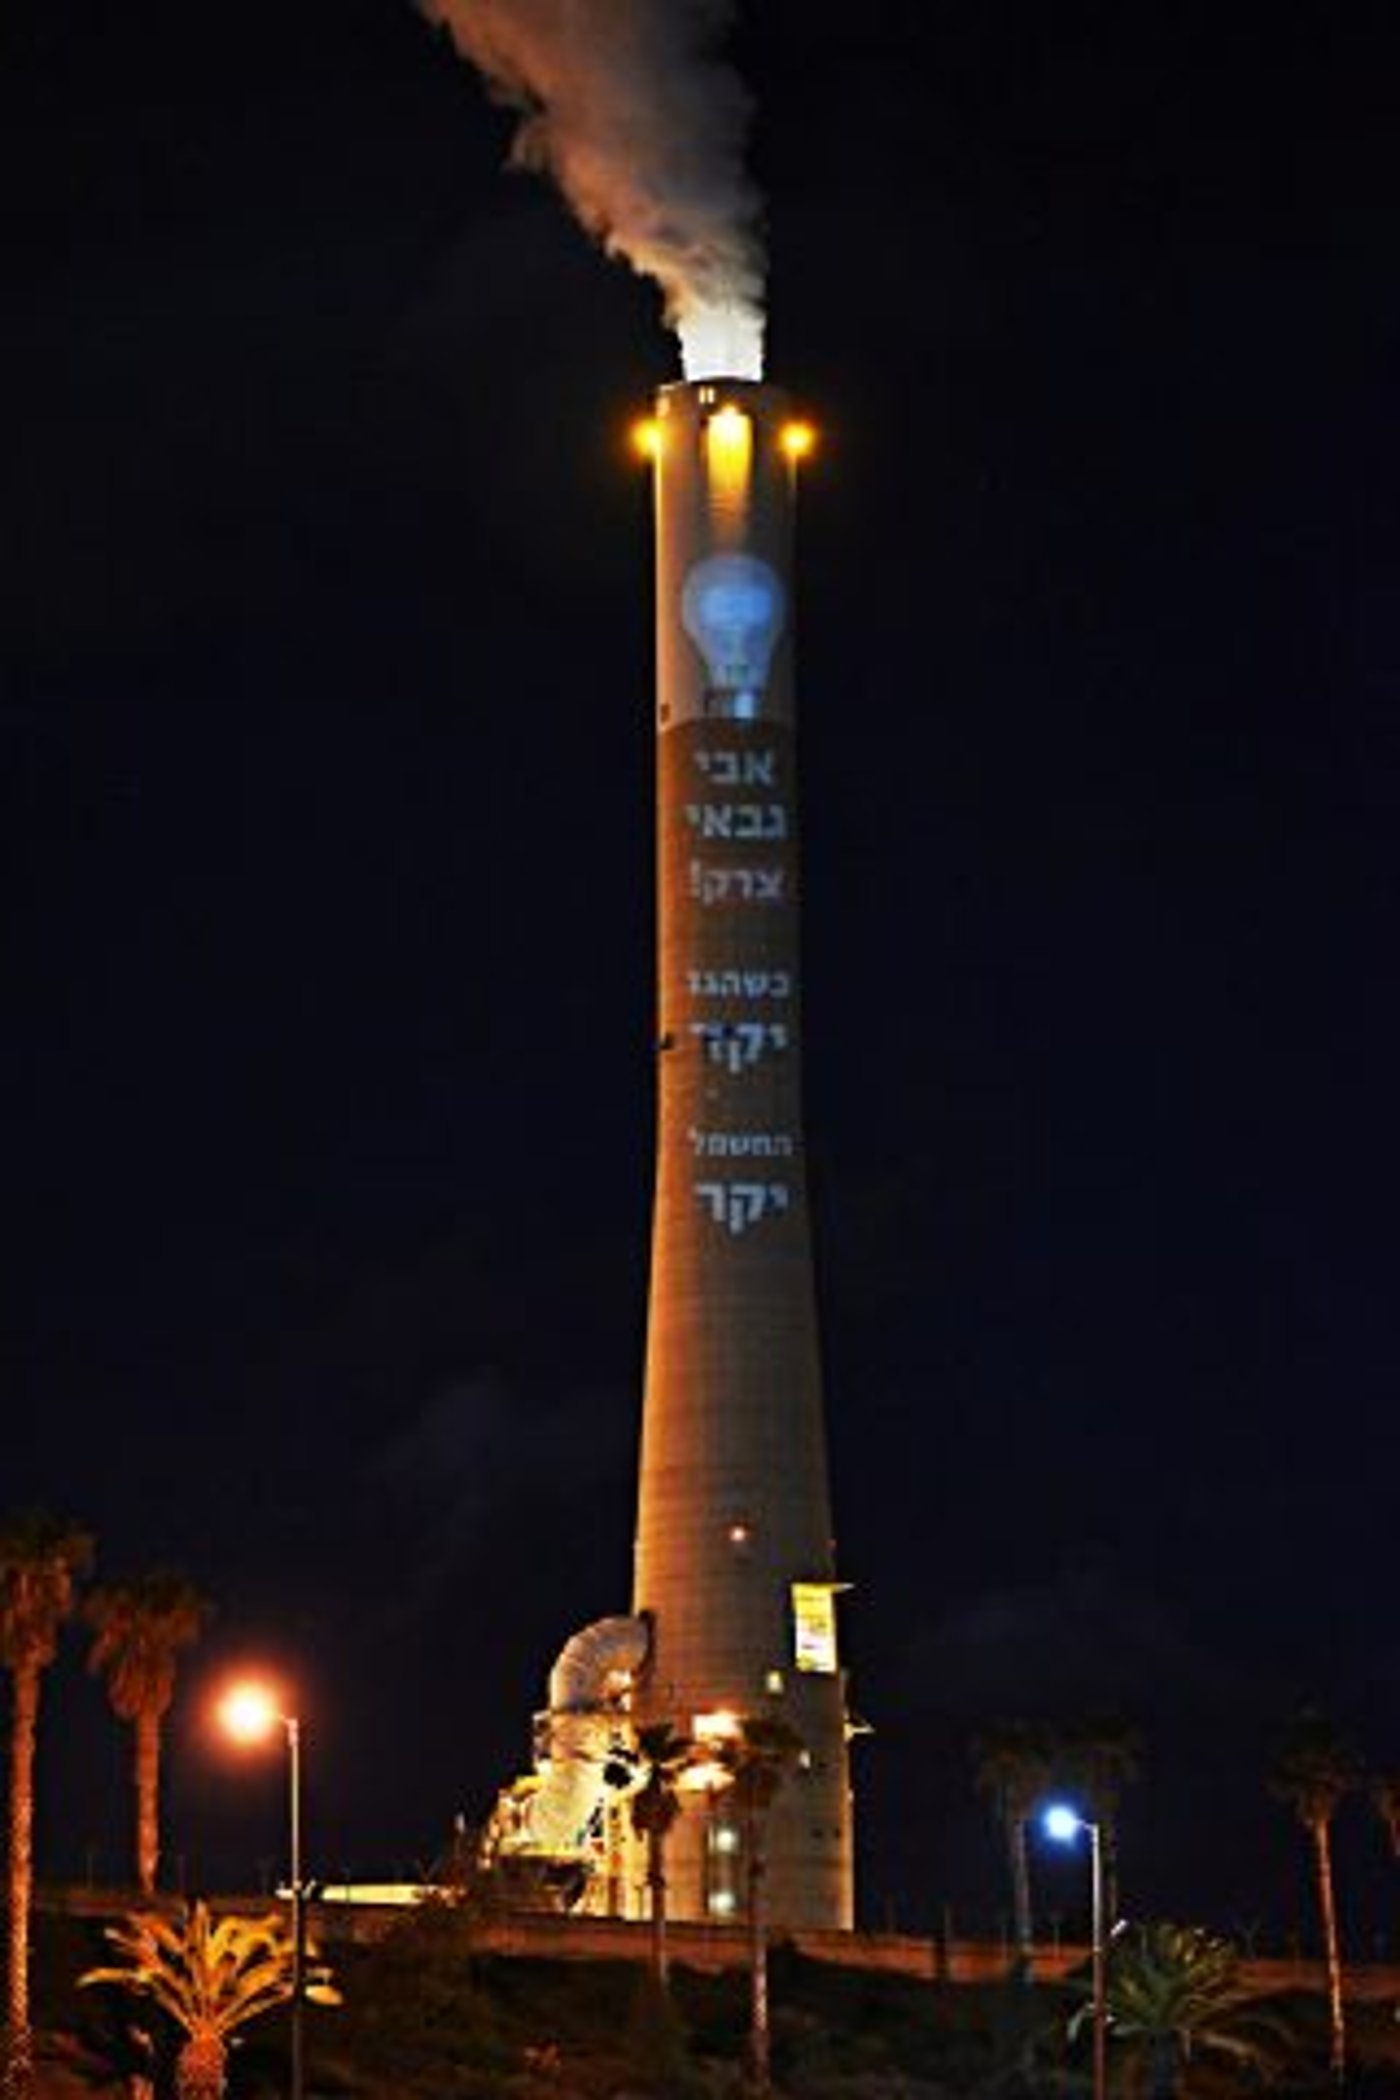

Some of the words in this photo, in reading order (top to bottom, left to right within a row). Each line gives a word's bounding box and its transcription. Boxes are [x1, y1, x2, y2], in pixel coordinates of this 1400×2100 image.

[695, 751, 773, 785] אבי
[686, 804, 788, 838] גבאי
[694, 1183, 789, 1234] יקר
